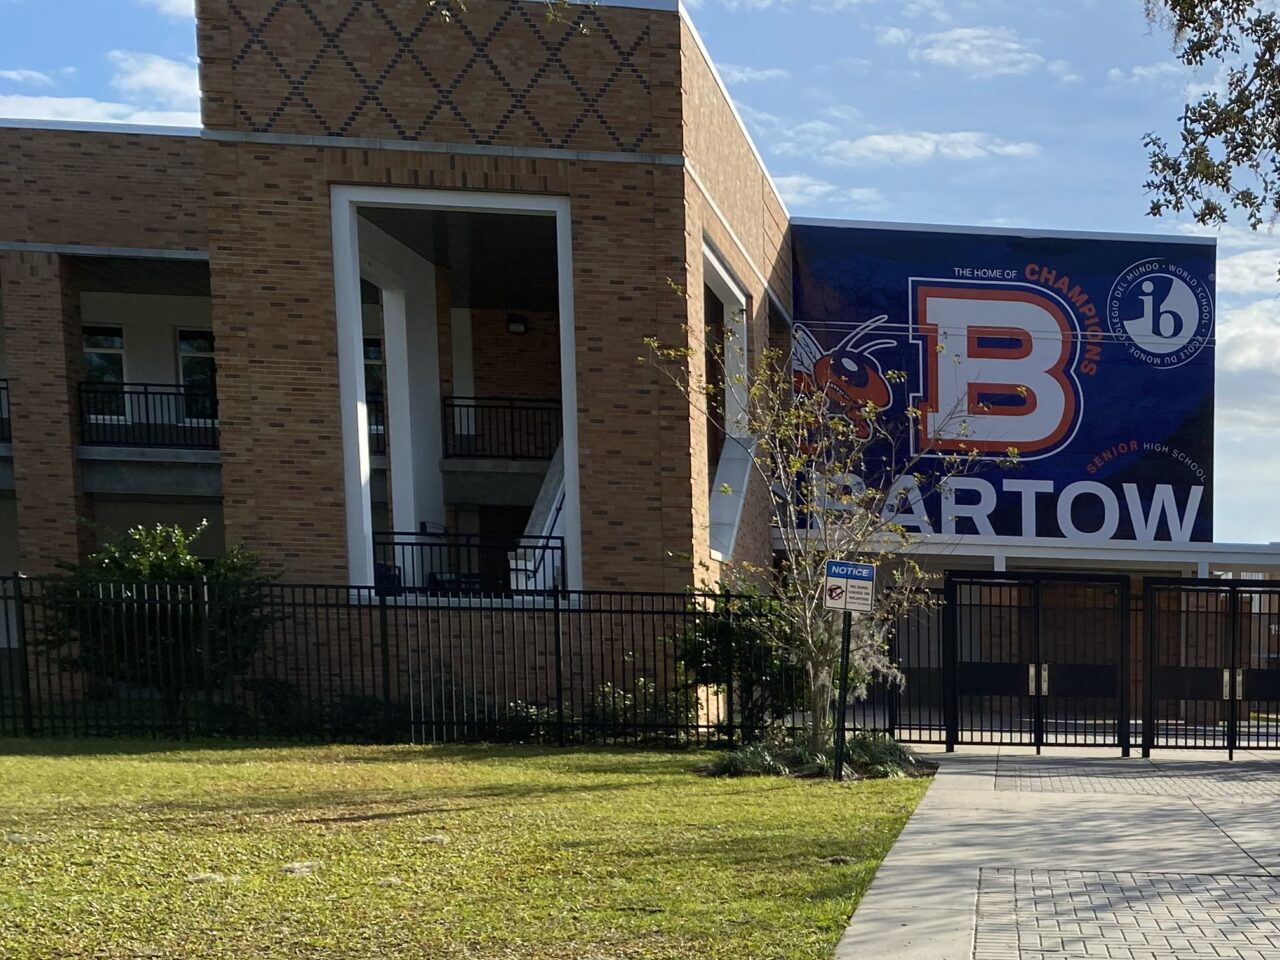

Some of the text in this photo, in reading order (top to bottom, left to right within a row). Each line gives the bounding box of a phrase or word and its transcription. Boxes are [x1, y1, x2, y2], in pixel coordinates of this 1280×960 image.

[1111, 262, 1159, 341] COLEGIO DEL MUNDO
[1168, 263, 1210, 325] WORLD SCHOOL
[953, 263, 1104, 376] THE HOME OF CHAMPIONS
[1128, 345, 1161, 365] MONDE
[1164, 355, 1178, 365] DU
[1087, 440, 1207, 482] SENIOR HIGH SCHOOL
[831, 566, 870, 577] NOTICE
